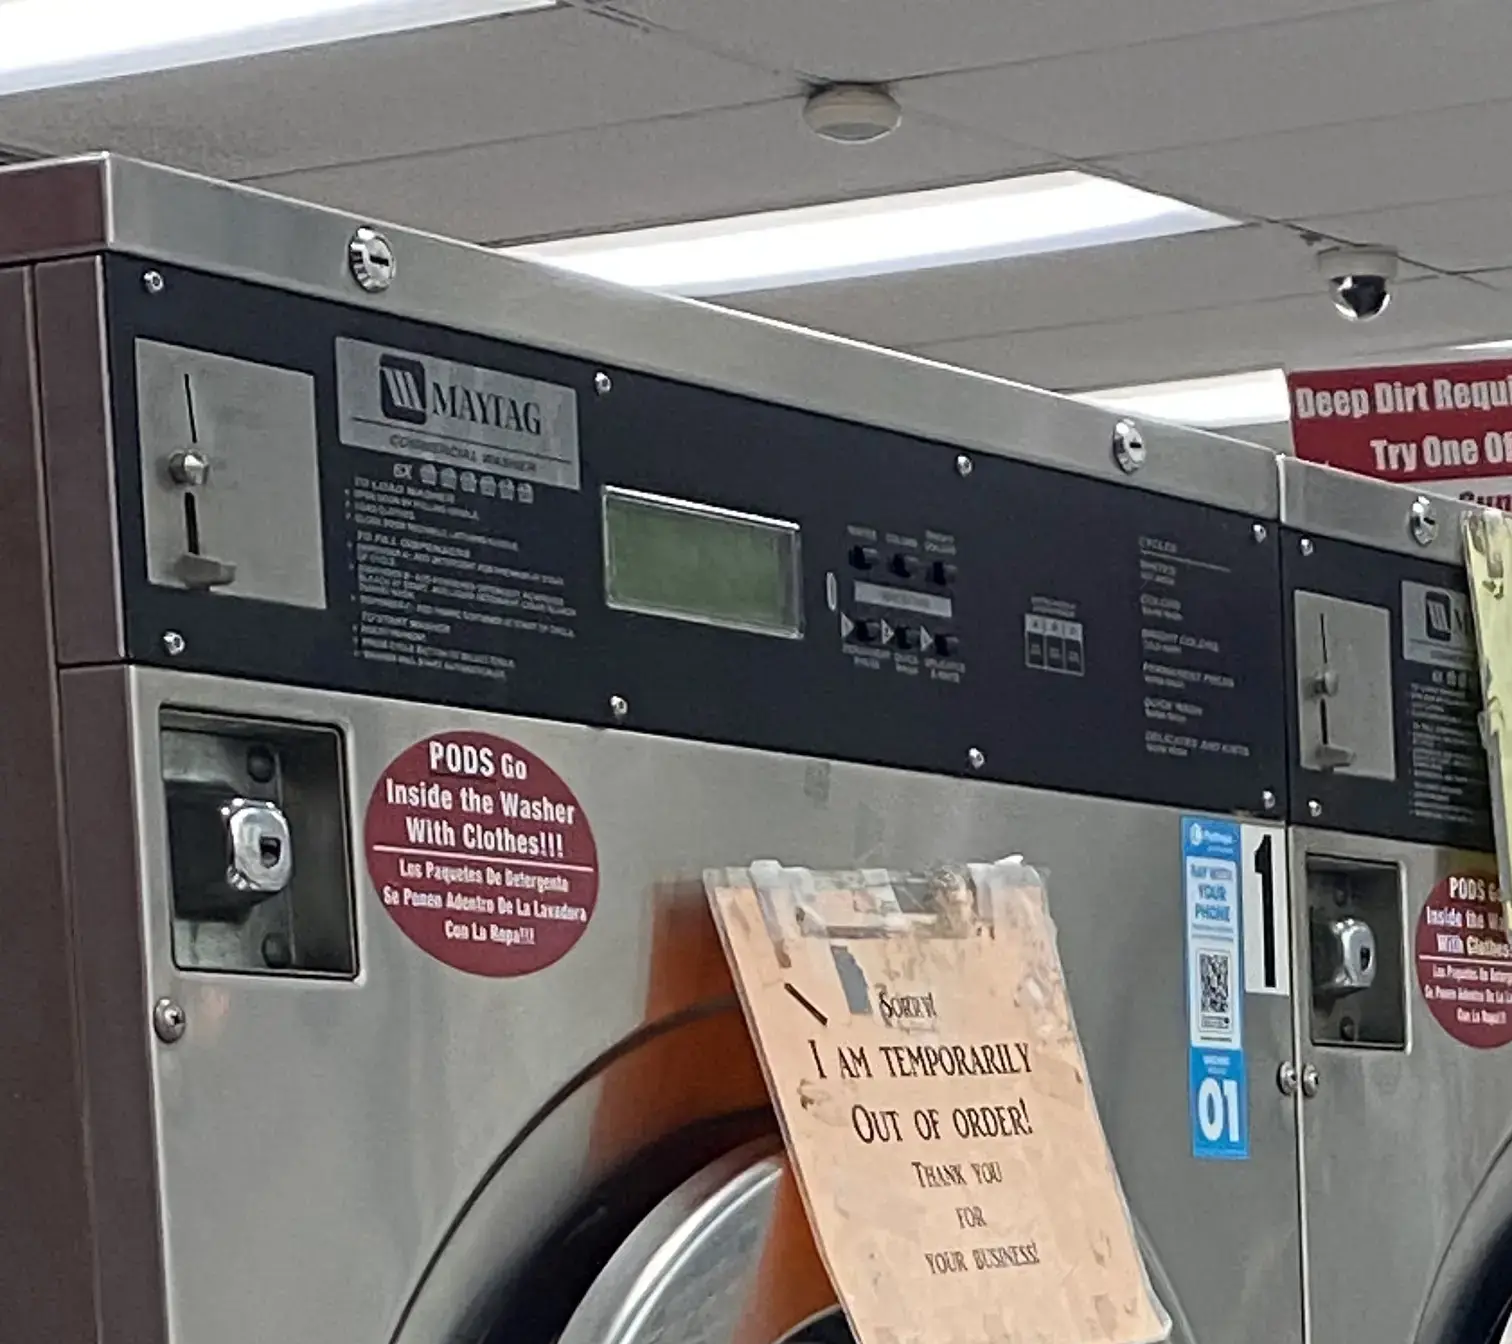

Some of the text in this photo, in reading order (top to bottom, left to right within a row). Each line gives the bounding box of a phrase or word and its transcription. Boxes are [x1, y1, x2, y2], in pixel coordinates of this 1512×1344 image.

[432, 382, 542, 435] MAYTAG
[1295, 387, 1369, 419] Deep
[1374, 380, 1429, 413] Dirt
[1370, 438, 1418, 473] Try
[1421, 434, 1479, 468] One
[429, 740, 528, 780] PODS Go
[386, 778, 576, 825] Inside the Washer
[405, 816, 564, 858] With Clothes!!!
[383, 885, 400, 906] Se
[516, 898, 531, 917] La
[1449, 876, 1486, 900] PODS
[1254, 833, 1277, 988] 1
[1426, 905, 1463, 927] Inside
[1465, 909, 1485, 930] the
[807, 1039, 1032, 1080] I AM TEMPORARILY
[851, 1096, 1033, 1144] OUT OF ORDER!
[1198, 1077, 1240, 1142] 01
[911, 1161, 1003, 1189] THANK YOU
[954, 1205, 988, 1230] FOR
[924, 1239, 1041, 1275] YOUR BUSINESS!
